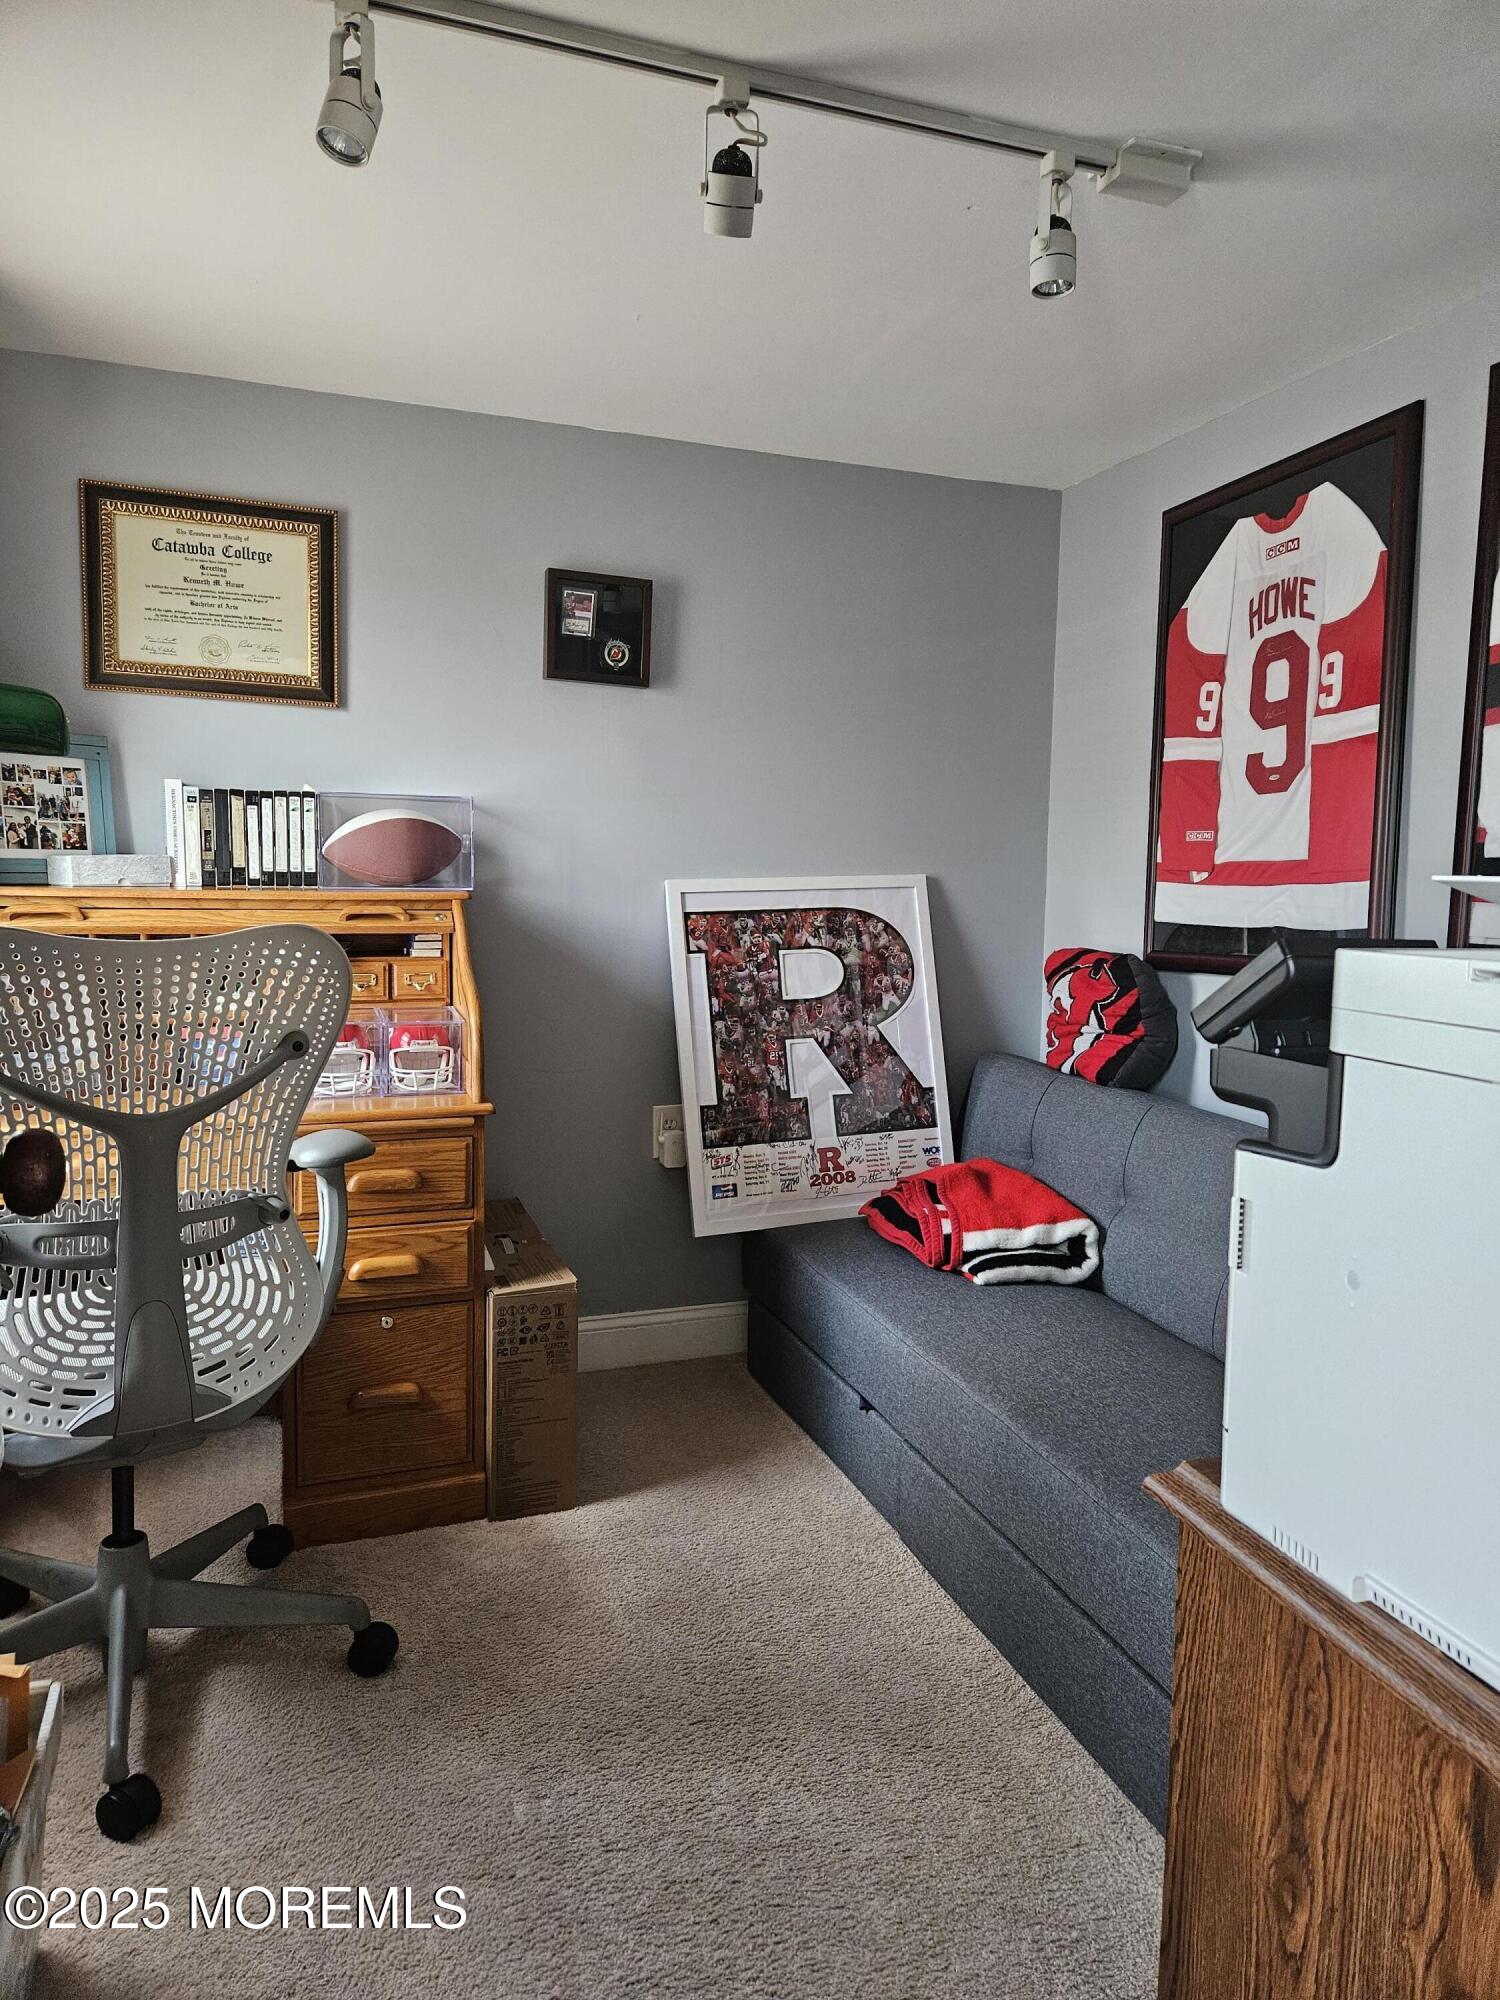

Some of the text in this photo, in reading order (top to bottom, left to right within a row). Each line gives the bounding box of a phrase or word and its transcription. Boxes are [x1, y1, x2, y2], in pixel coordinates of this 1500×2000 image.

[152, 537, 215, 556] Catawba
[222, 545, 273, 564] College
[1266, 538, 1299, 560] CCM
[183, 576, 211, 586] Kenneth
[1249, 577, 1316, 640] HOWE
[1318, 650, 1344, 710] 9
[1196, 682, 1222, 732] 9
[1245, 630, 1310, 795] 9
[713, 1154, 732, 1166] STS
[816, 1146, 845, 1172] R
[809, 1171, 856, 1187] 2008
